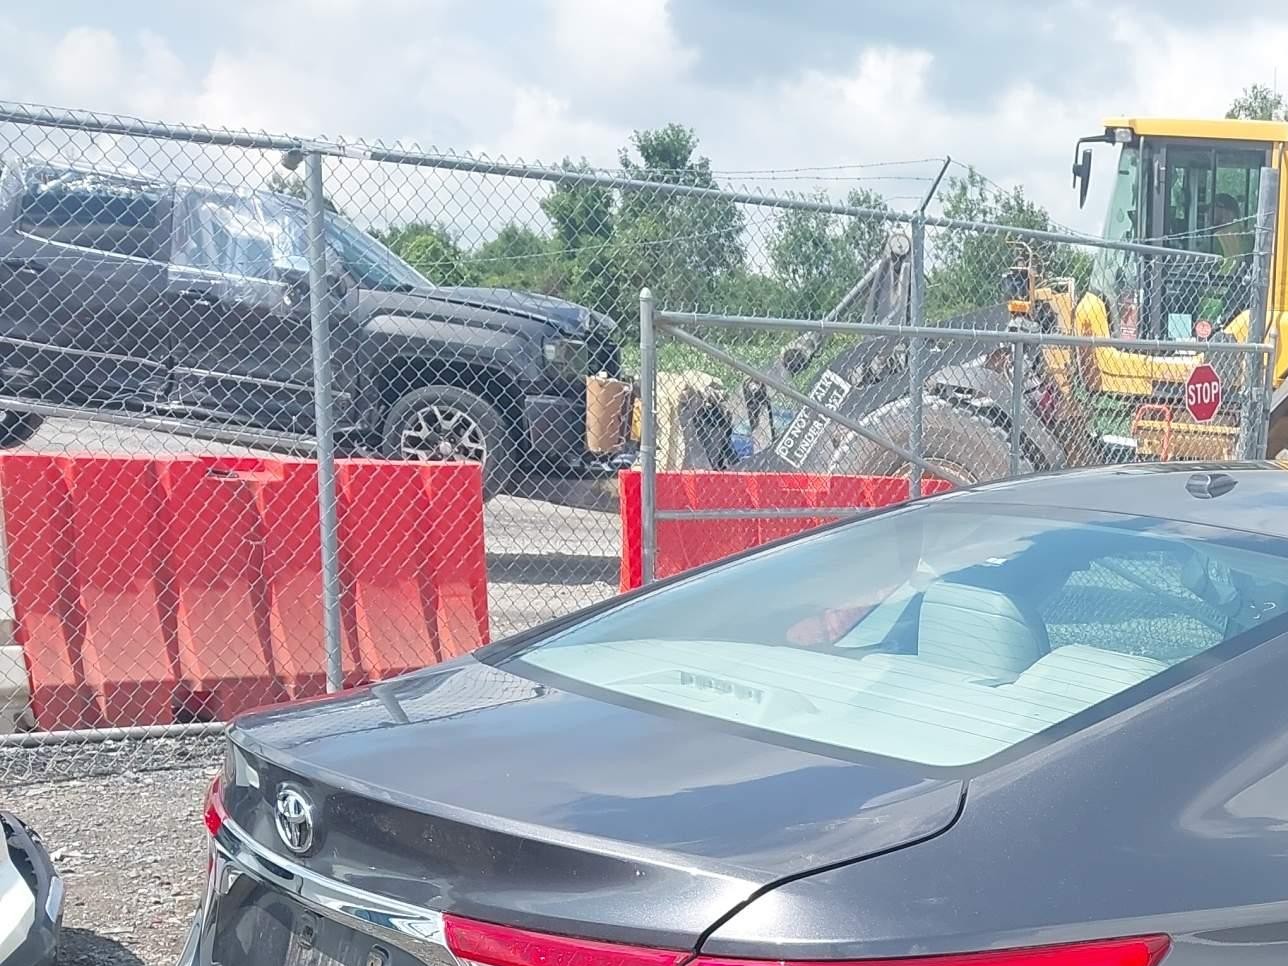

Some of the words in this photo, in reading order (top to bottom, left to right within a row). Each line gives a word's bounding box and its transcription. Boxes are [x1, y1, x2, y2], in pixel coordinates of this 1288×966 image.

[1188, 381, 1219, 405] STOP
[778, 437, 795, 457] DO
[794, 420, 823, 458] UNDER
